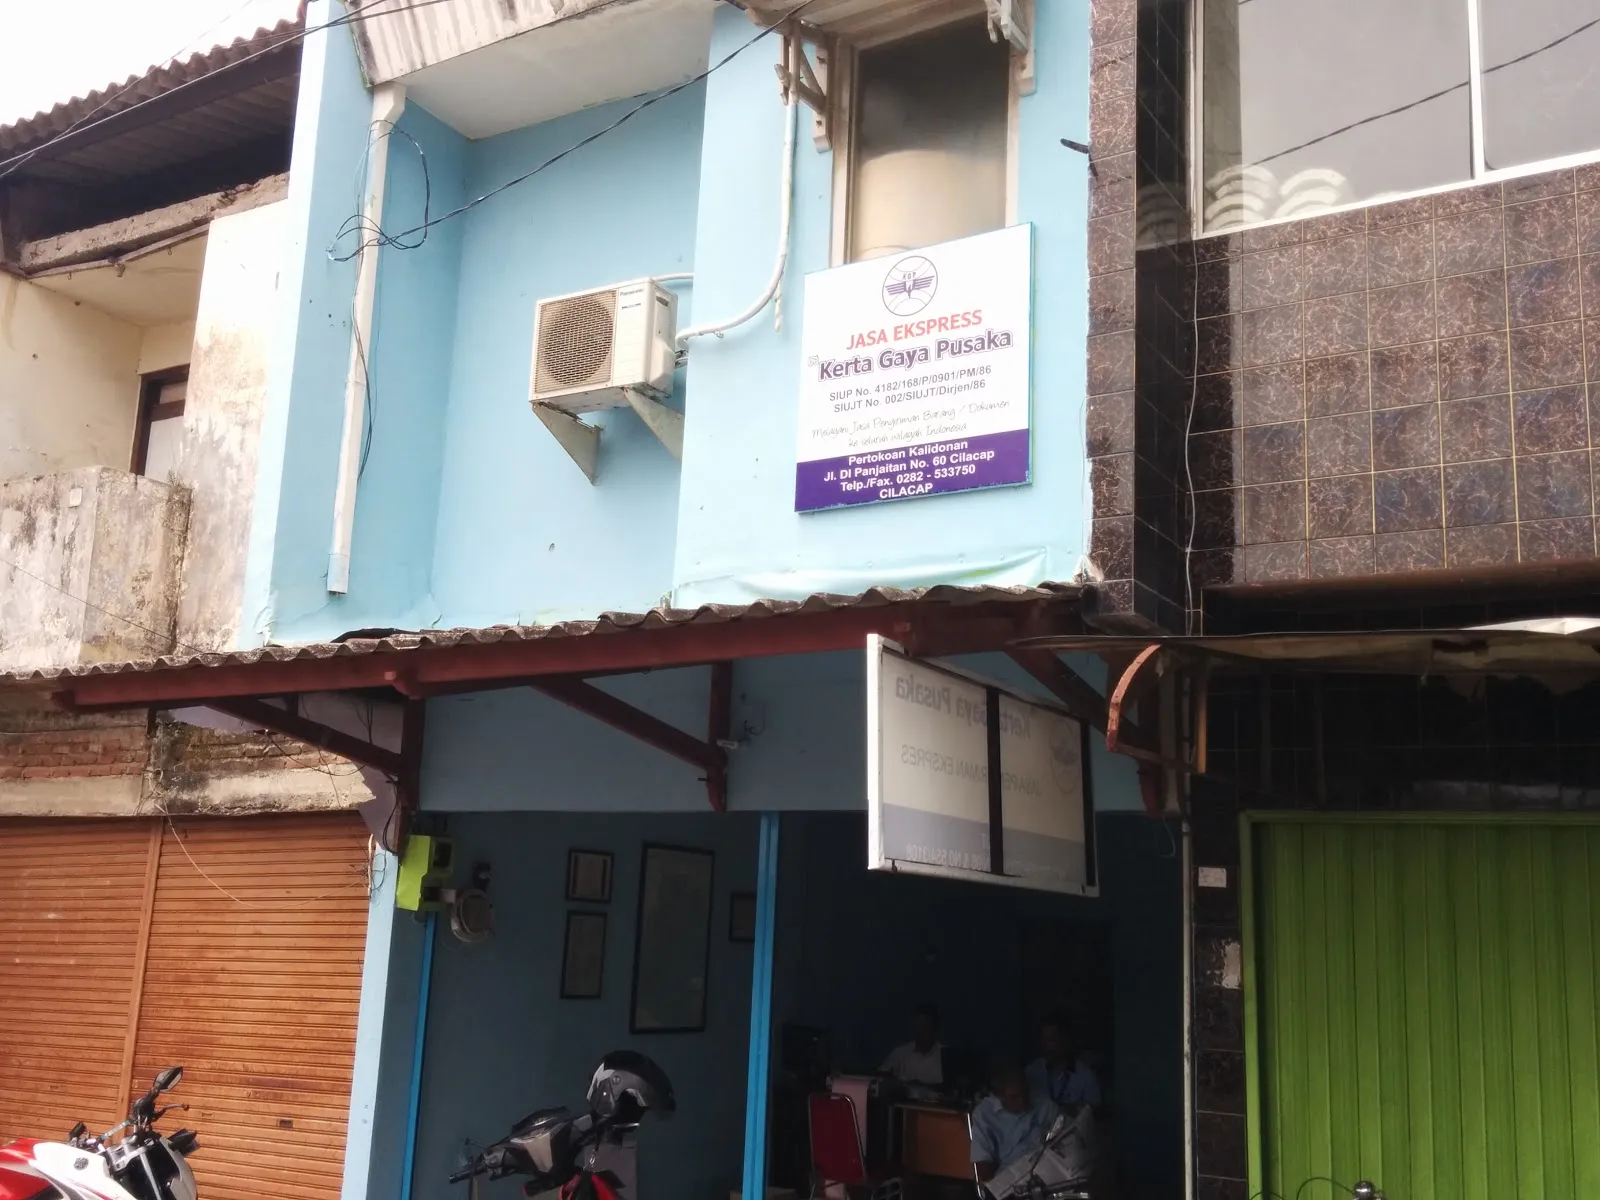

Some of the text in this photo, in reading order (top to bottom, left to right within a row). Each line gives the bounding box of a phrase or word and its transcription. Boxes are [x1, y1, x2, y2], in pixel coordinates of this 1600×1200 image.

[846, 309, 983, 350] JASA EKSPRESS
[818, 356, 873, 381] Kerta
[878, 345, 931, 371] Gaya
[935, 329, 1013, 360] Pusaka
[829, 365, 992, 402] SIUP No. 4182/168/P/0901/PM/86
[833, 400, 863, 413] SIUJT
[885, 379, 986, 404] 002/SIUJT/Dirjen/86
[849, 421, 870, 435] Jasa
[923, 408, 956, 420] Barang
[968, 399, 1010, 414] Dokumen
[848, 437, 858, 447] ke
[861, 434, 889, 446] seluruh
[925, 422, 967, 437] Indonesia
[823, 449, 995, 482] Jl. DI Panjaitan No. 60 Cilacap
[848, 441, 969, 466] Pertokoan Kalidonan
[841, 477, 893, 494] Telp./Fax.
[897, 472, 923, 485] 0282
[934, 464, 976, 479] 533750
[879, 483, 934, 499] CILACAP
